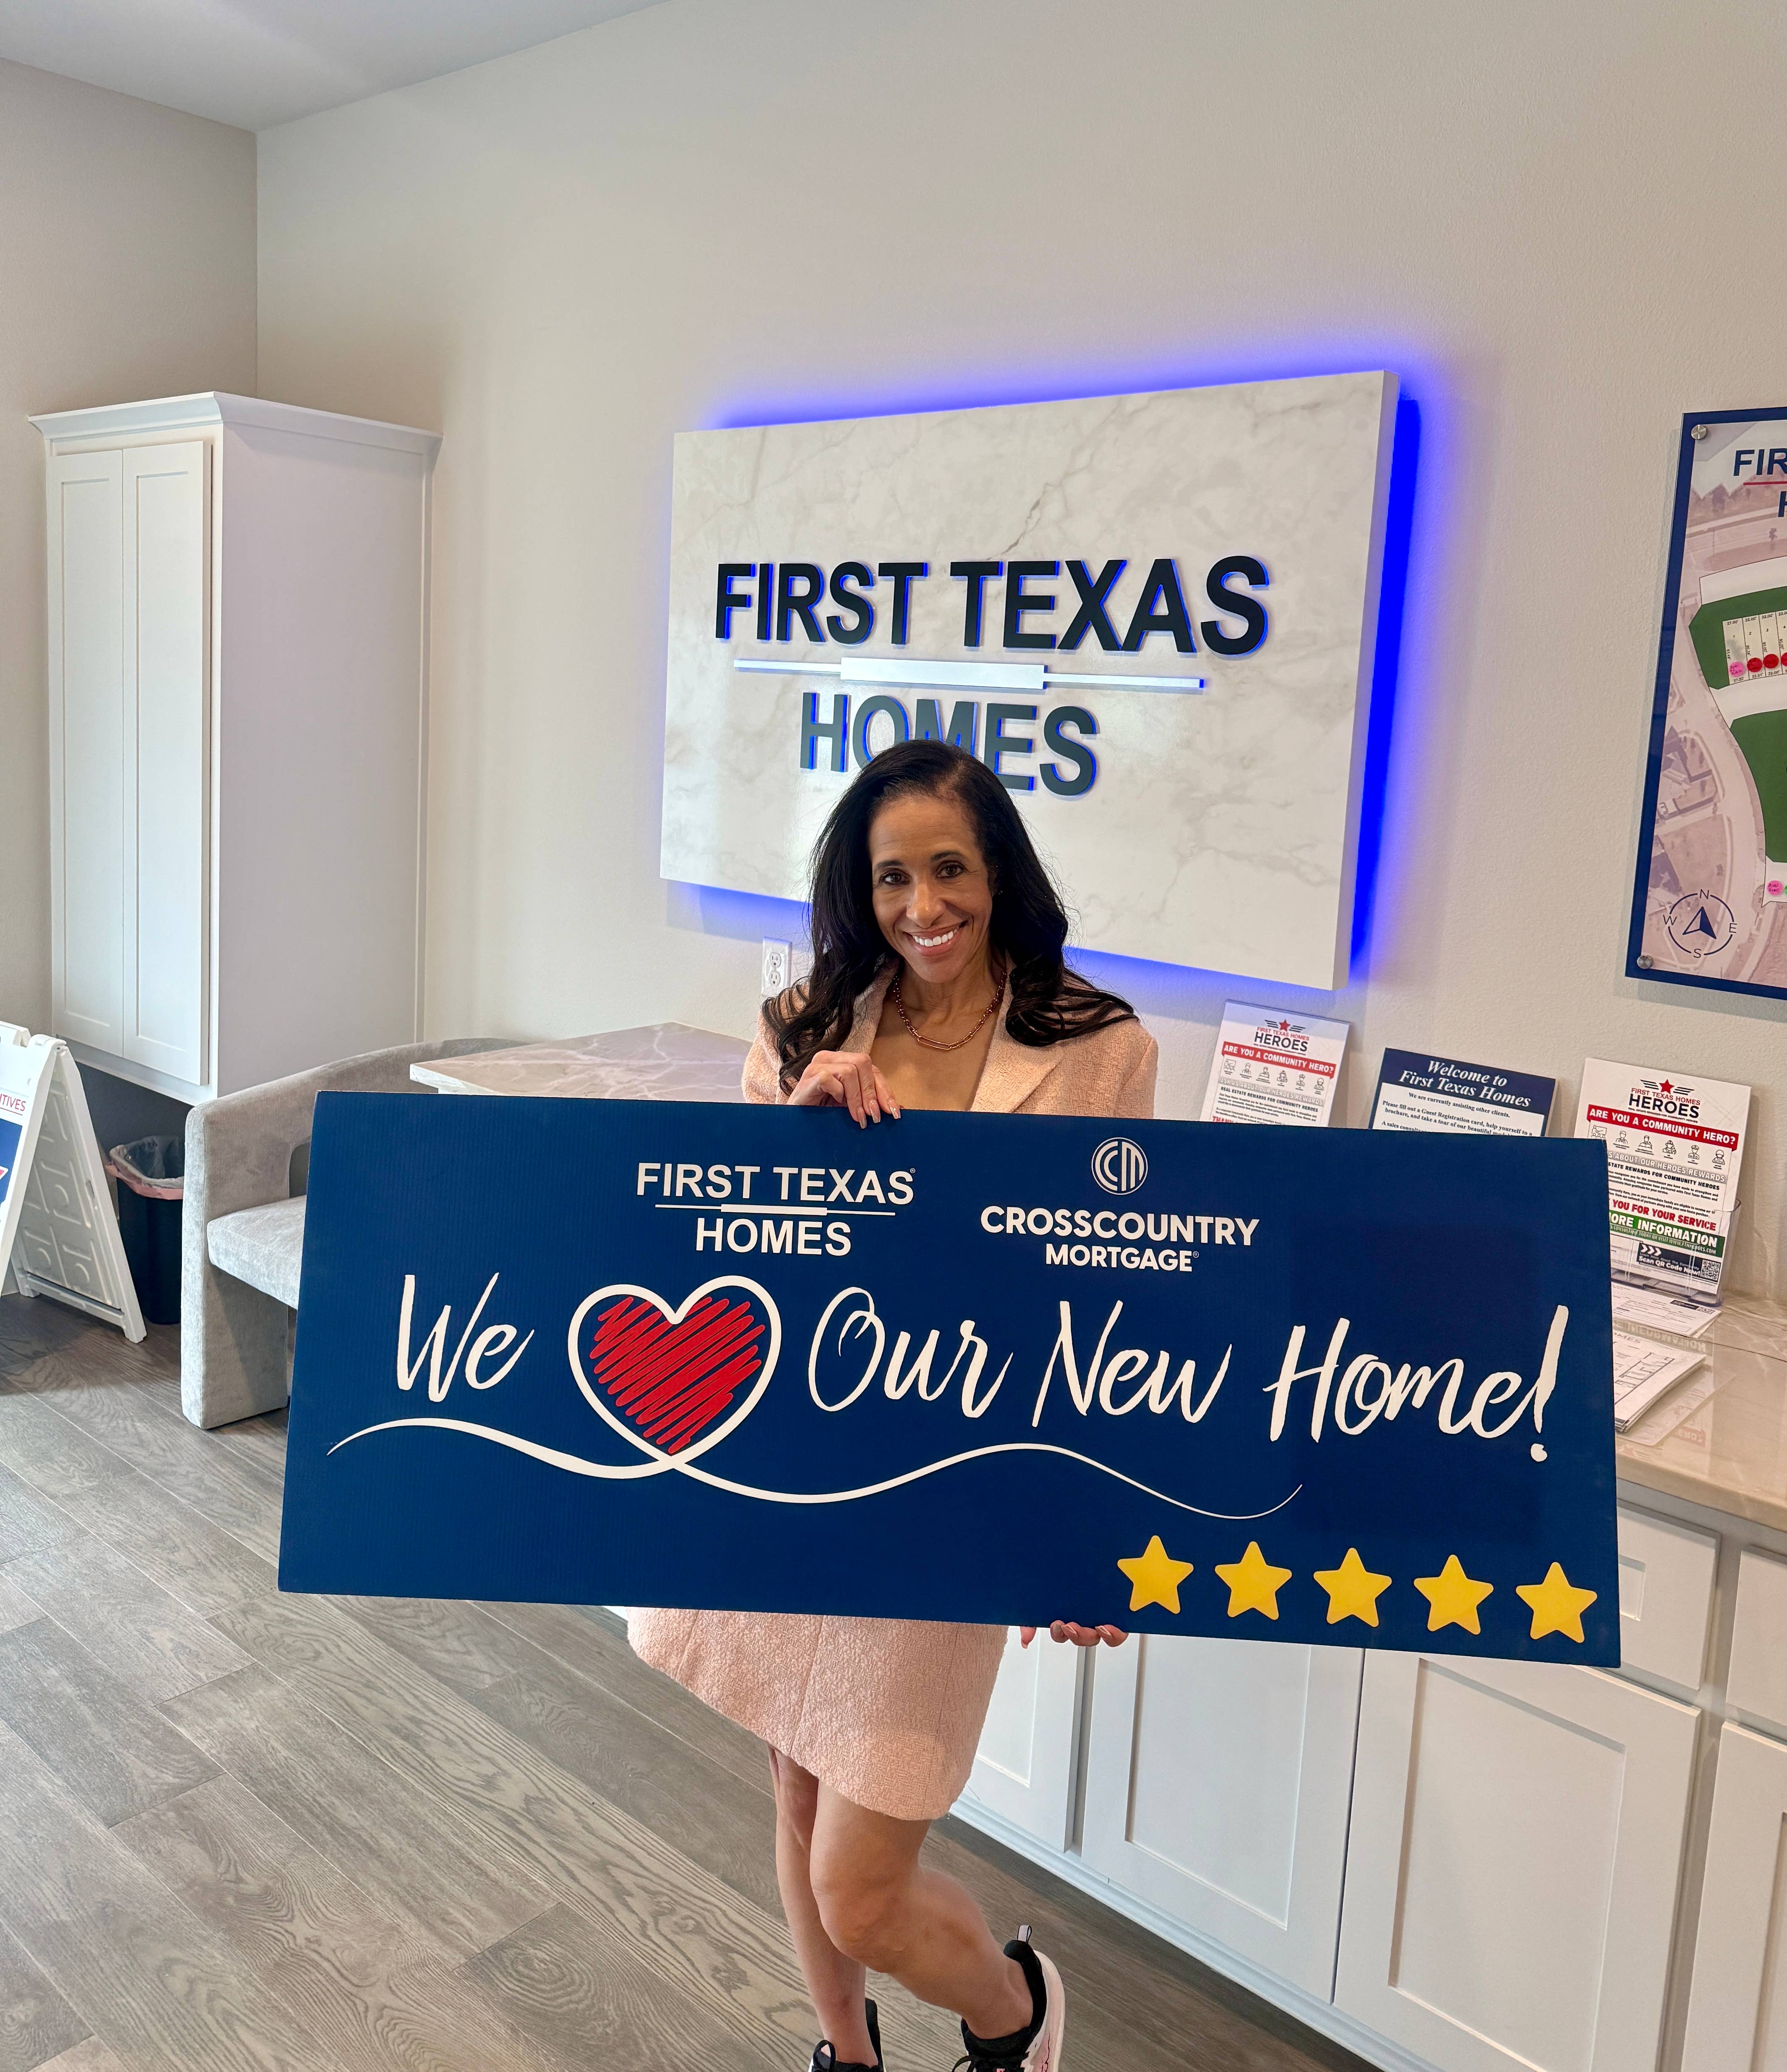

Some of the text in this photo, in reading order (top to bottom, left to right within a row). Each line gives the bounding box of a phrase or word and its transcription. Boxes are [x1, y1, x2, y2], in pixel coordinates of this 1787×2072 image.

[1733, 449, 1787, 476] FIR
[715, 555, 1269, 655] FIRST TEXAS
[1700, 889, 1710, 899] N
[1663, 915, 1677, 925] W
[1729, 923, 1737, 933] E
[1693, 948, 1702, 958] S
[1254, 1032, 1308, 1052] HEROES
[1224, 1045, 1238, 1053] ARE
[1240, 1048, 1254, 1057] YOU
[1263, 1053, 1307, 1068] COMMUNITY
[1309, 1062, 1334, 1074] HERO?
[1428, 1061, 1507, 1087] Welcome to
[1399, 1070, 1531, 1107] First Texas Homes
[1652, 1092, 1673, 1100] TEXAS
[1676, 1096, 1701, 1105] HOMES
[0, 1093, 26, 1111] TIVES
[1427, 1098, 1452, 1106] currently
[1452, 1102, 1475, 1111] assisting
[1629, 1093, 1699, 1119] HEROES
[1385, 1108, 1409, 1118] brochure,
[1467, 1126, 1491, 1134] beautiful
[1438, 1112, 1470, 1123] Registration
[1589, 1108, 1736, 1145] ARE YOU A COMMUNITY HERO?
[1615, 1153, 1725, 1182] ABOUT OUR HEROES REWARDS
[1625, 1166, 1651, 1175] REWARDS
[1664, 1174, 1697, 1186] COMMUNITY
[1698, 1181, 1720, 1190] HEROES
[637, 1162, 762, 1200] FIRST
[980, 1205, 1260, 1247] CROSSCOUNTRY
[1613, 1200, 1717, 1231] YOU FOR YOUR SERVICE
[696, 1218, 851, 1256] HOMES
[1609, 1213, 1717, 1247] ORE INFORMATION
[1639, 1256, 1654, 1265] Scan
[1666, 1263, 1682, 1272] Code
[397, 1272, 1569, 1462] We Our New Home!
